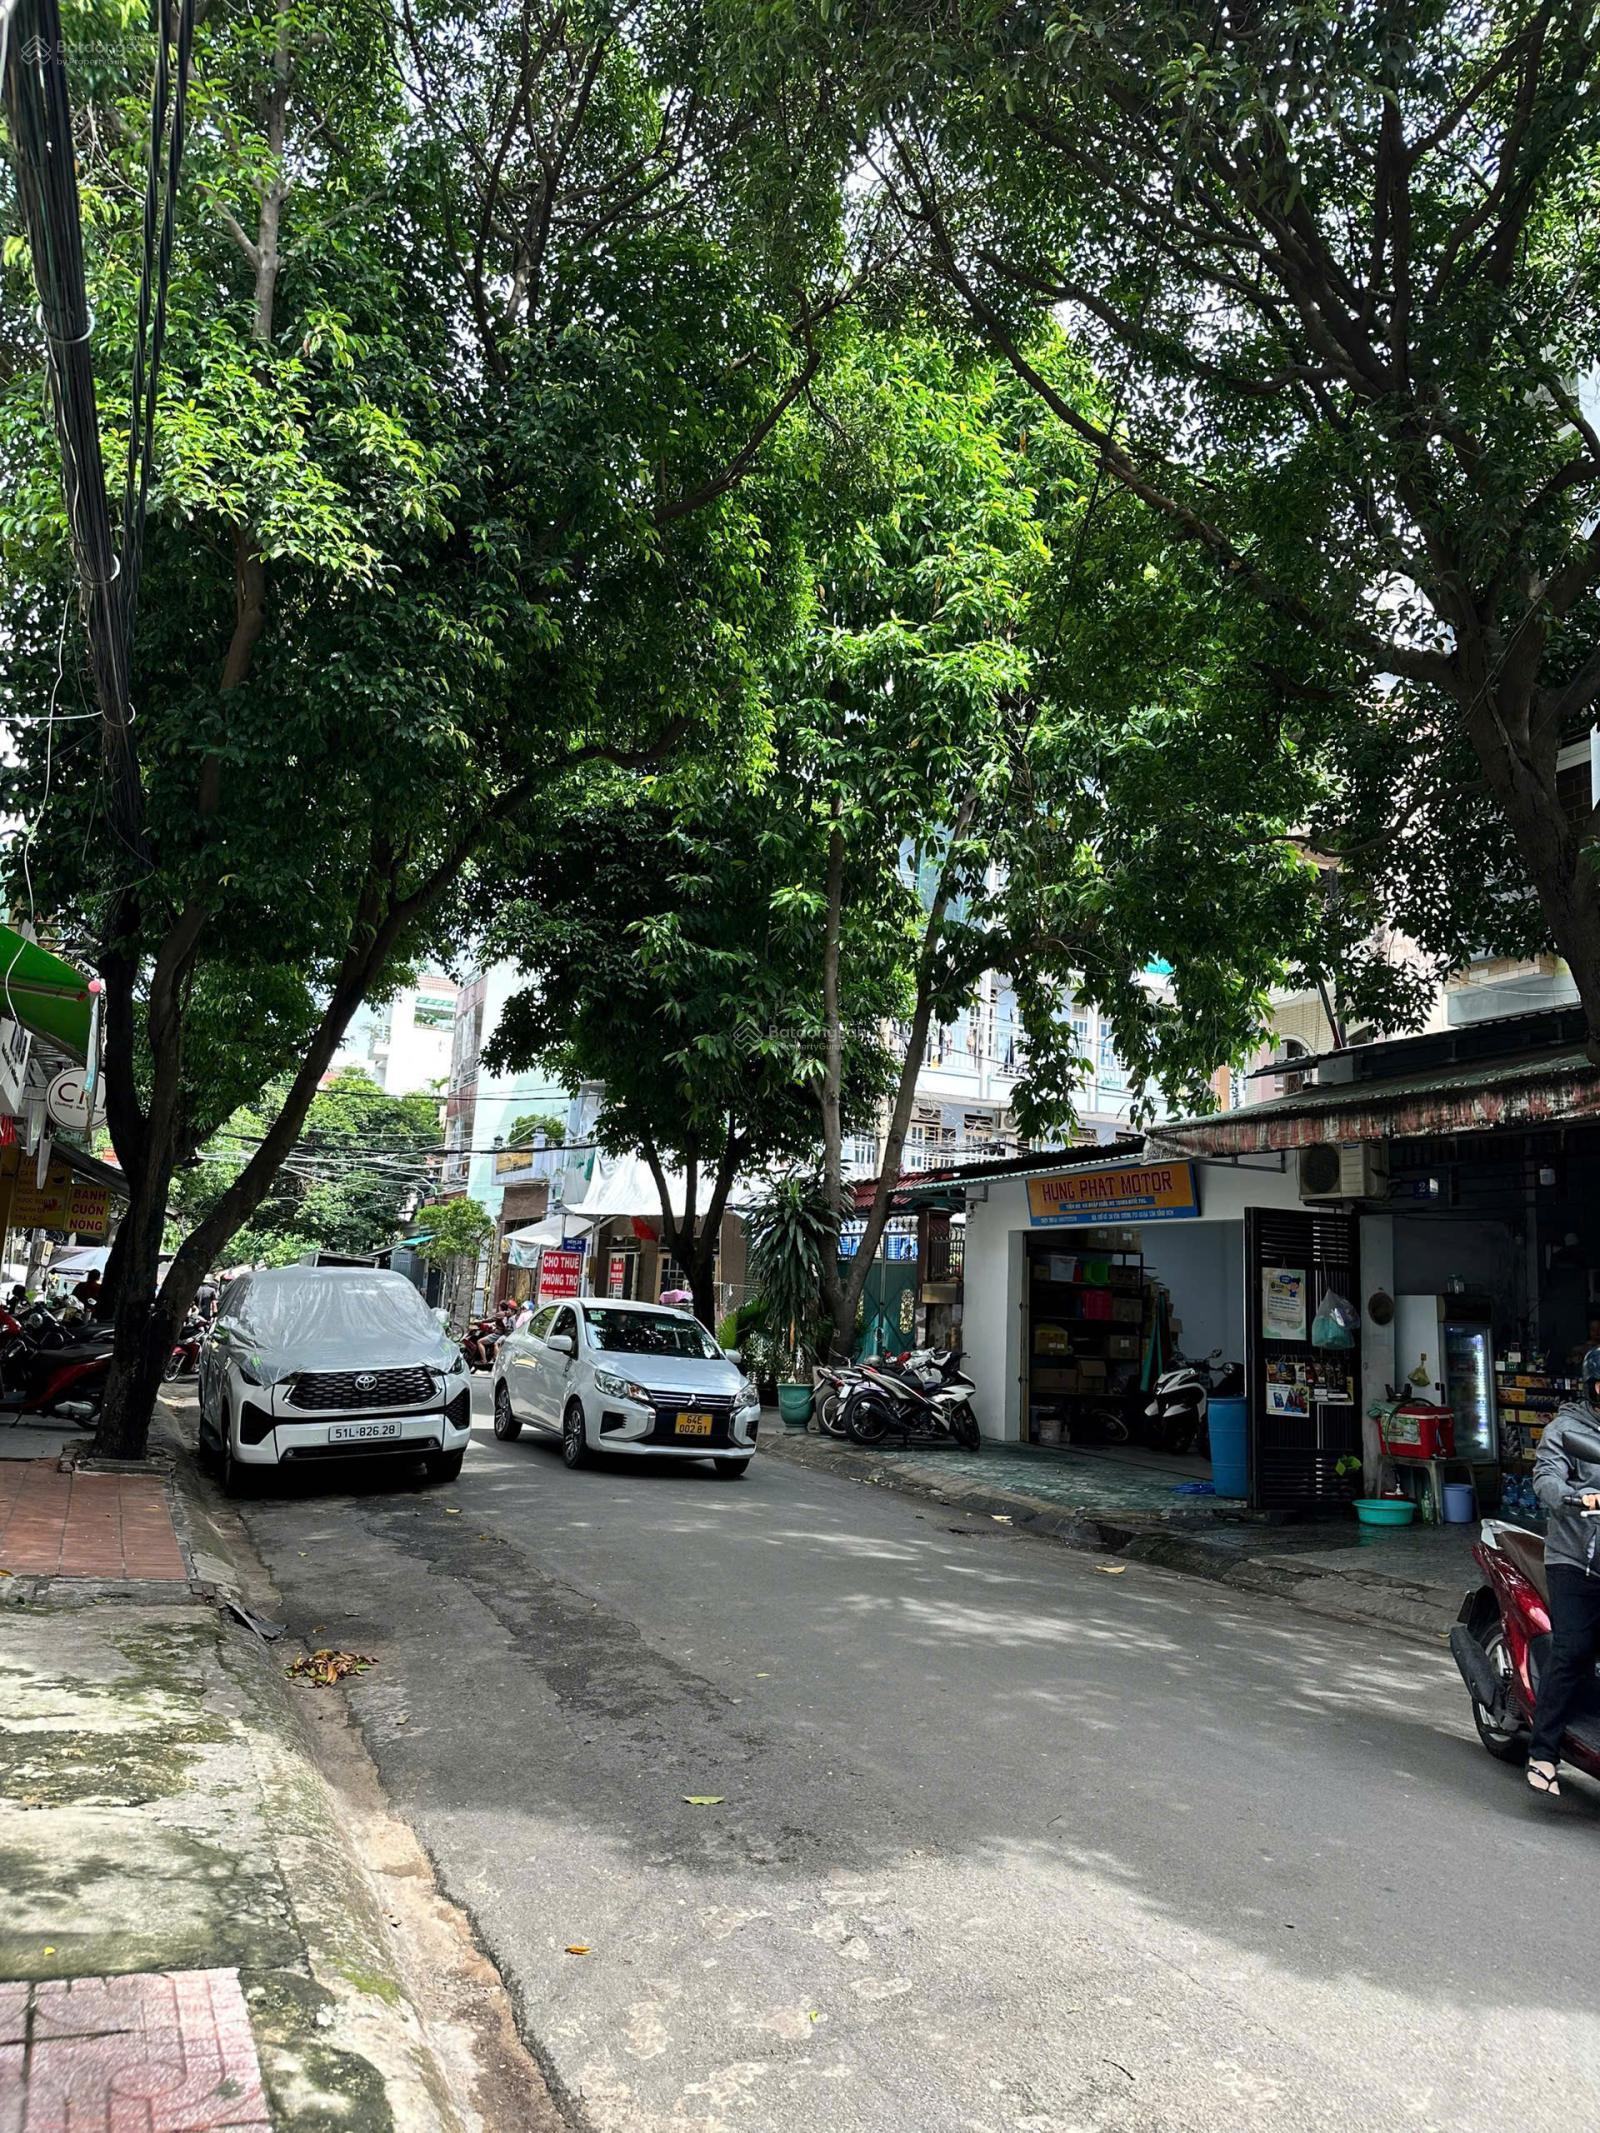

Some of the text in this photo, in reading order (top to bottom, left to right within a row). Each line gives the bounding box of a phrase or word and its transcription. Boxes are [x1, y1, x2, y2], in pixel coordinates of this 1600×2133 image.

[1120, 1171, 1173, 1195] MOTOR
[543, 1255, 559, 1268] CHO
[687, 1415, 703, 1424] 64E
